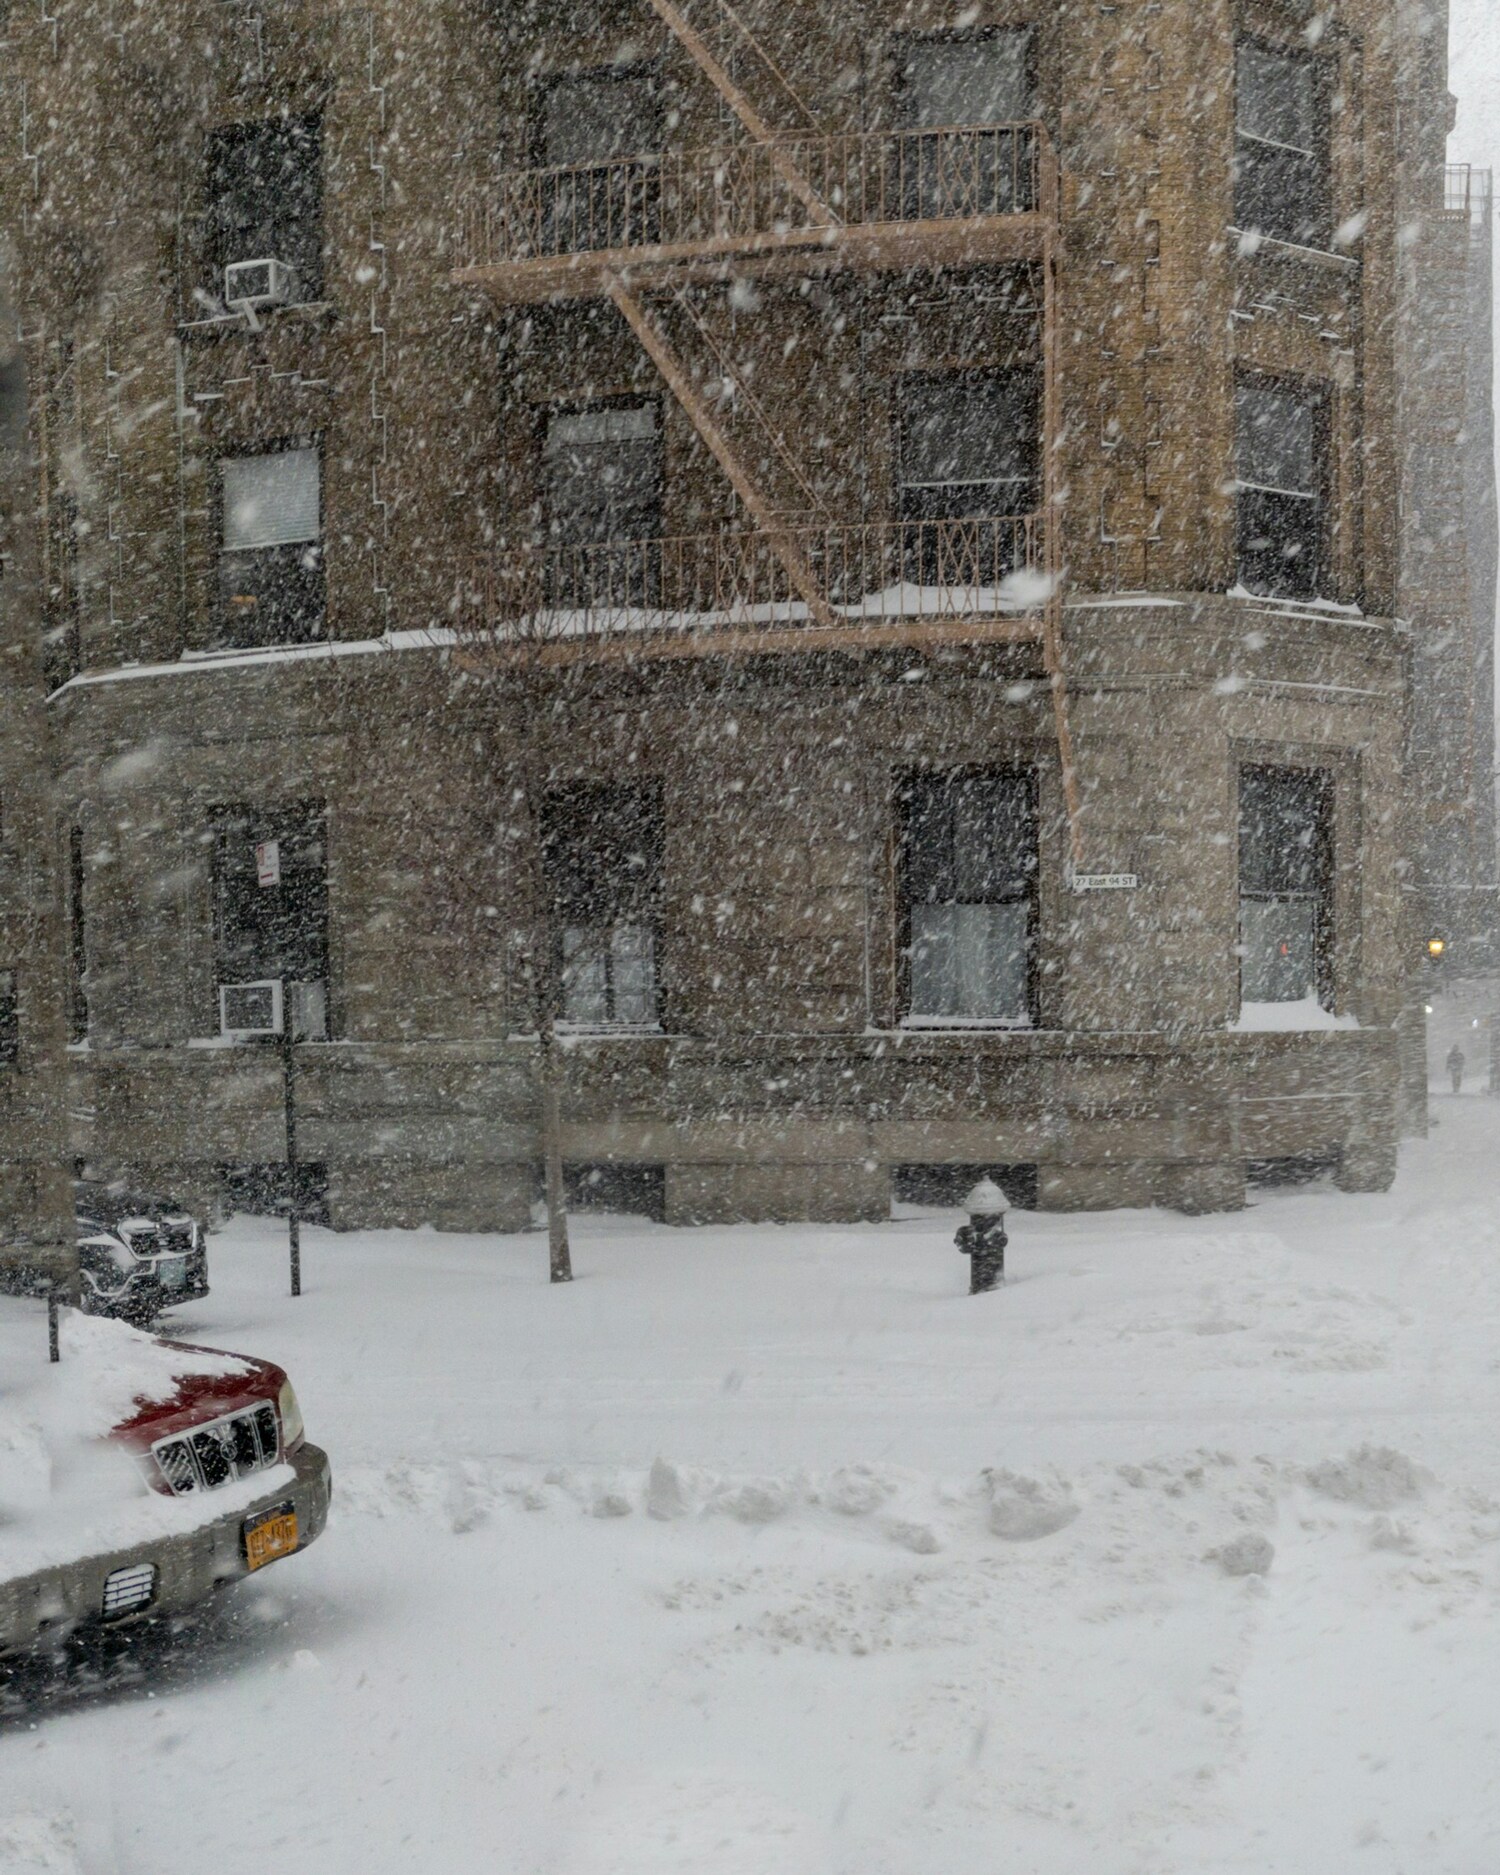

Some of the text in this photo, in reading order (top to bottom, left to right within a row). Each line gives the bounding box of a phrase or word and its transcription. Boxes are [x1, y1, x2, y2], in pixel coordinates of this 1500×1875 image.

[1088, 877, 1106, 886] East
[1109, 877, 1120, 886] 94
[1122, 876, 1134, 886] ST
